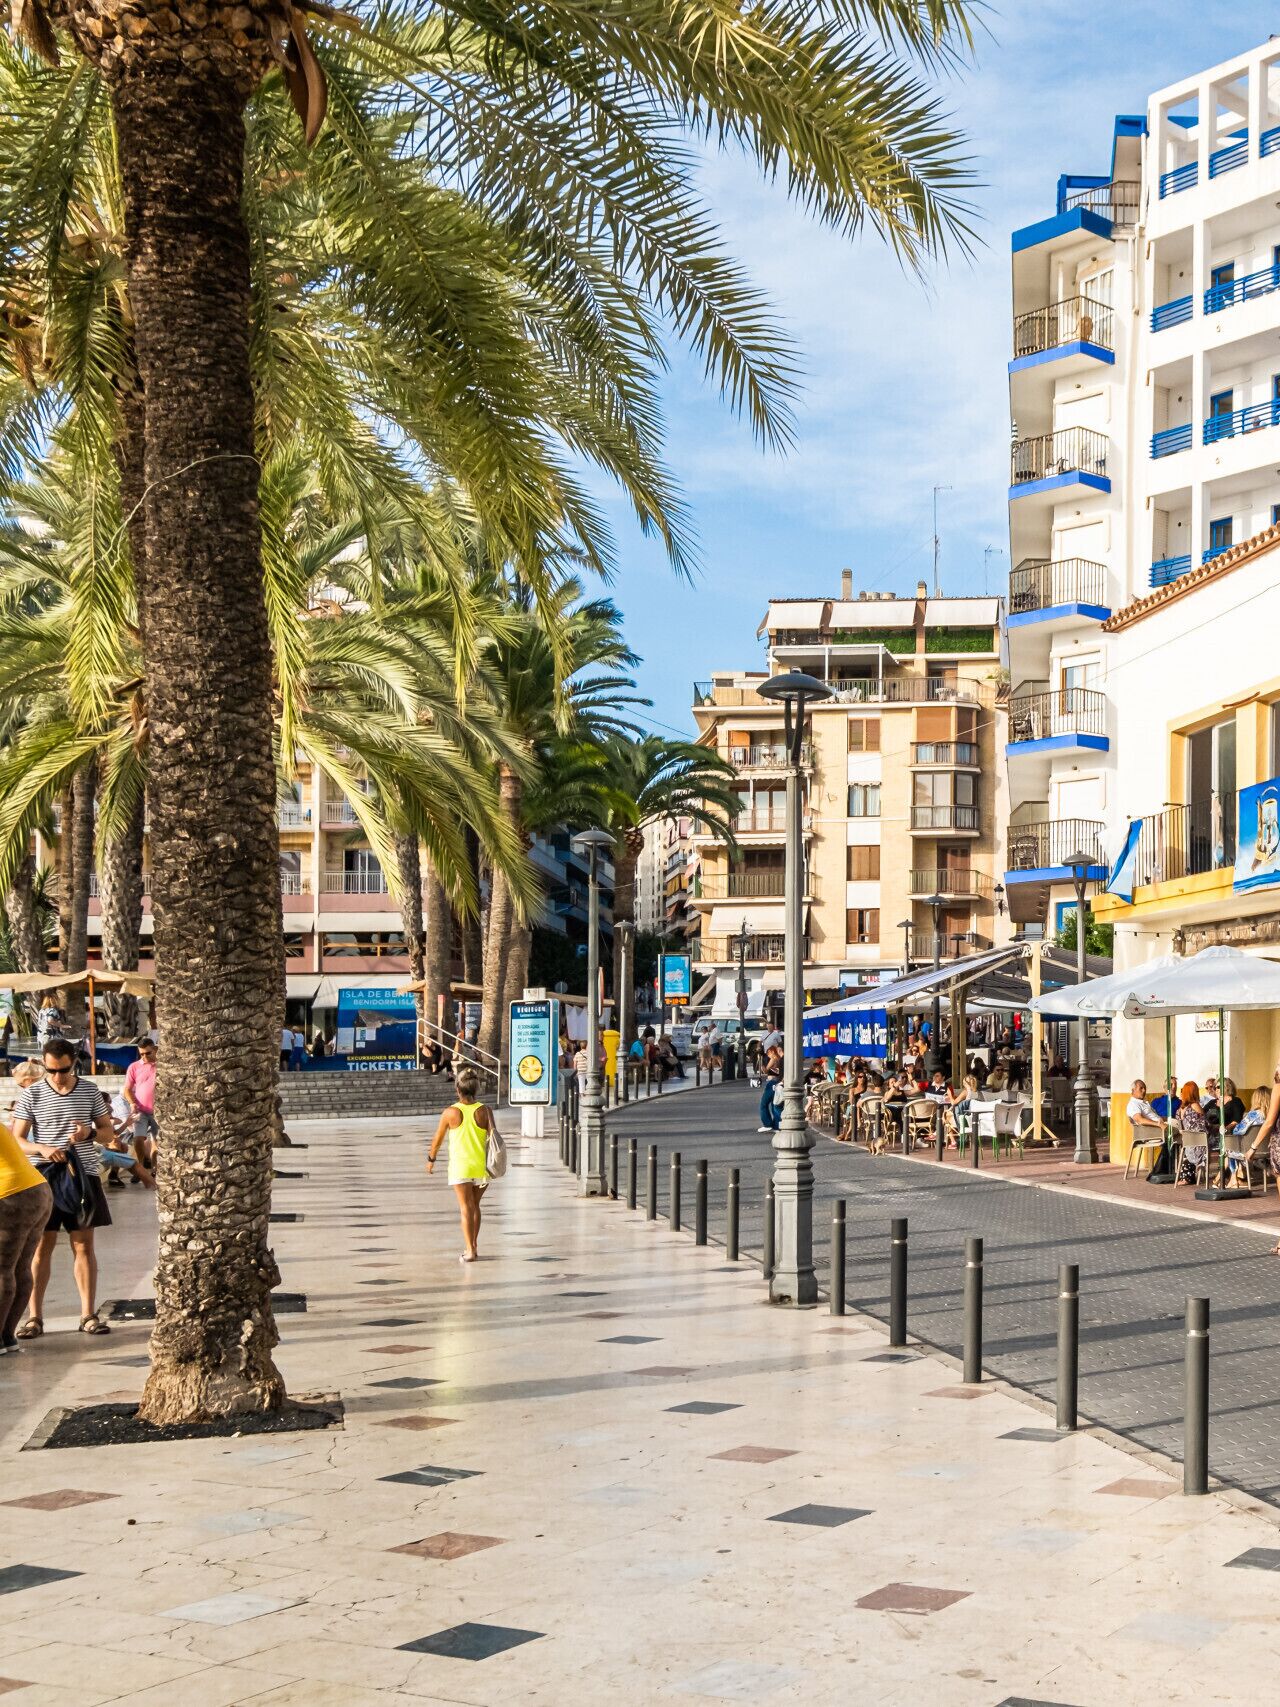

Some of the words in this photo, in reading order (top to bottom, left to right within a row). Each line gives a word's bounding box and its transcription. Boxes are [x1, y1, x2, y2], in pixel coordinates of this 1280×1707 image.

[342, 990, 364, 998] ISLA
[368, 990, 380, 998] DE
[347, 1061, 401, 1071] TICKETS
